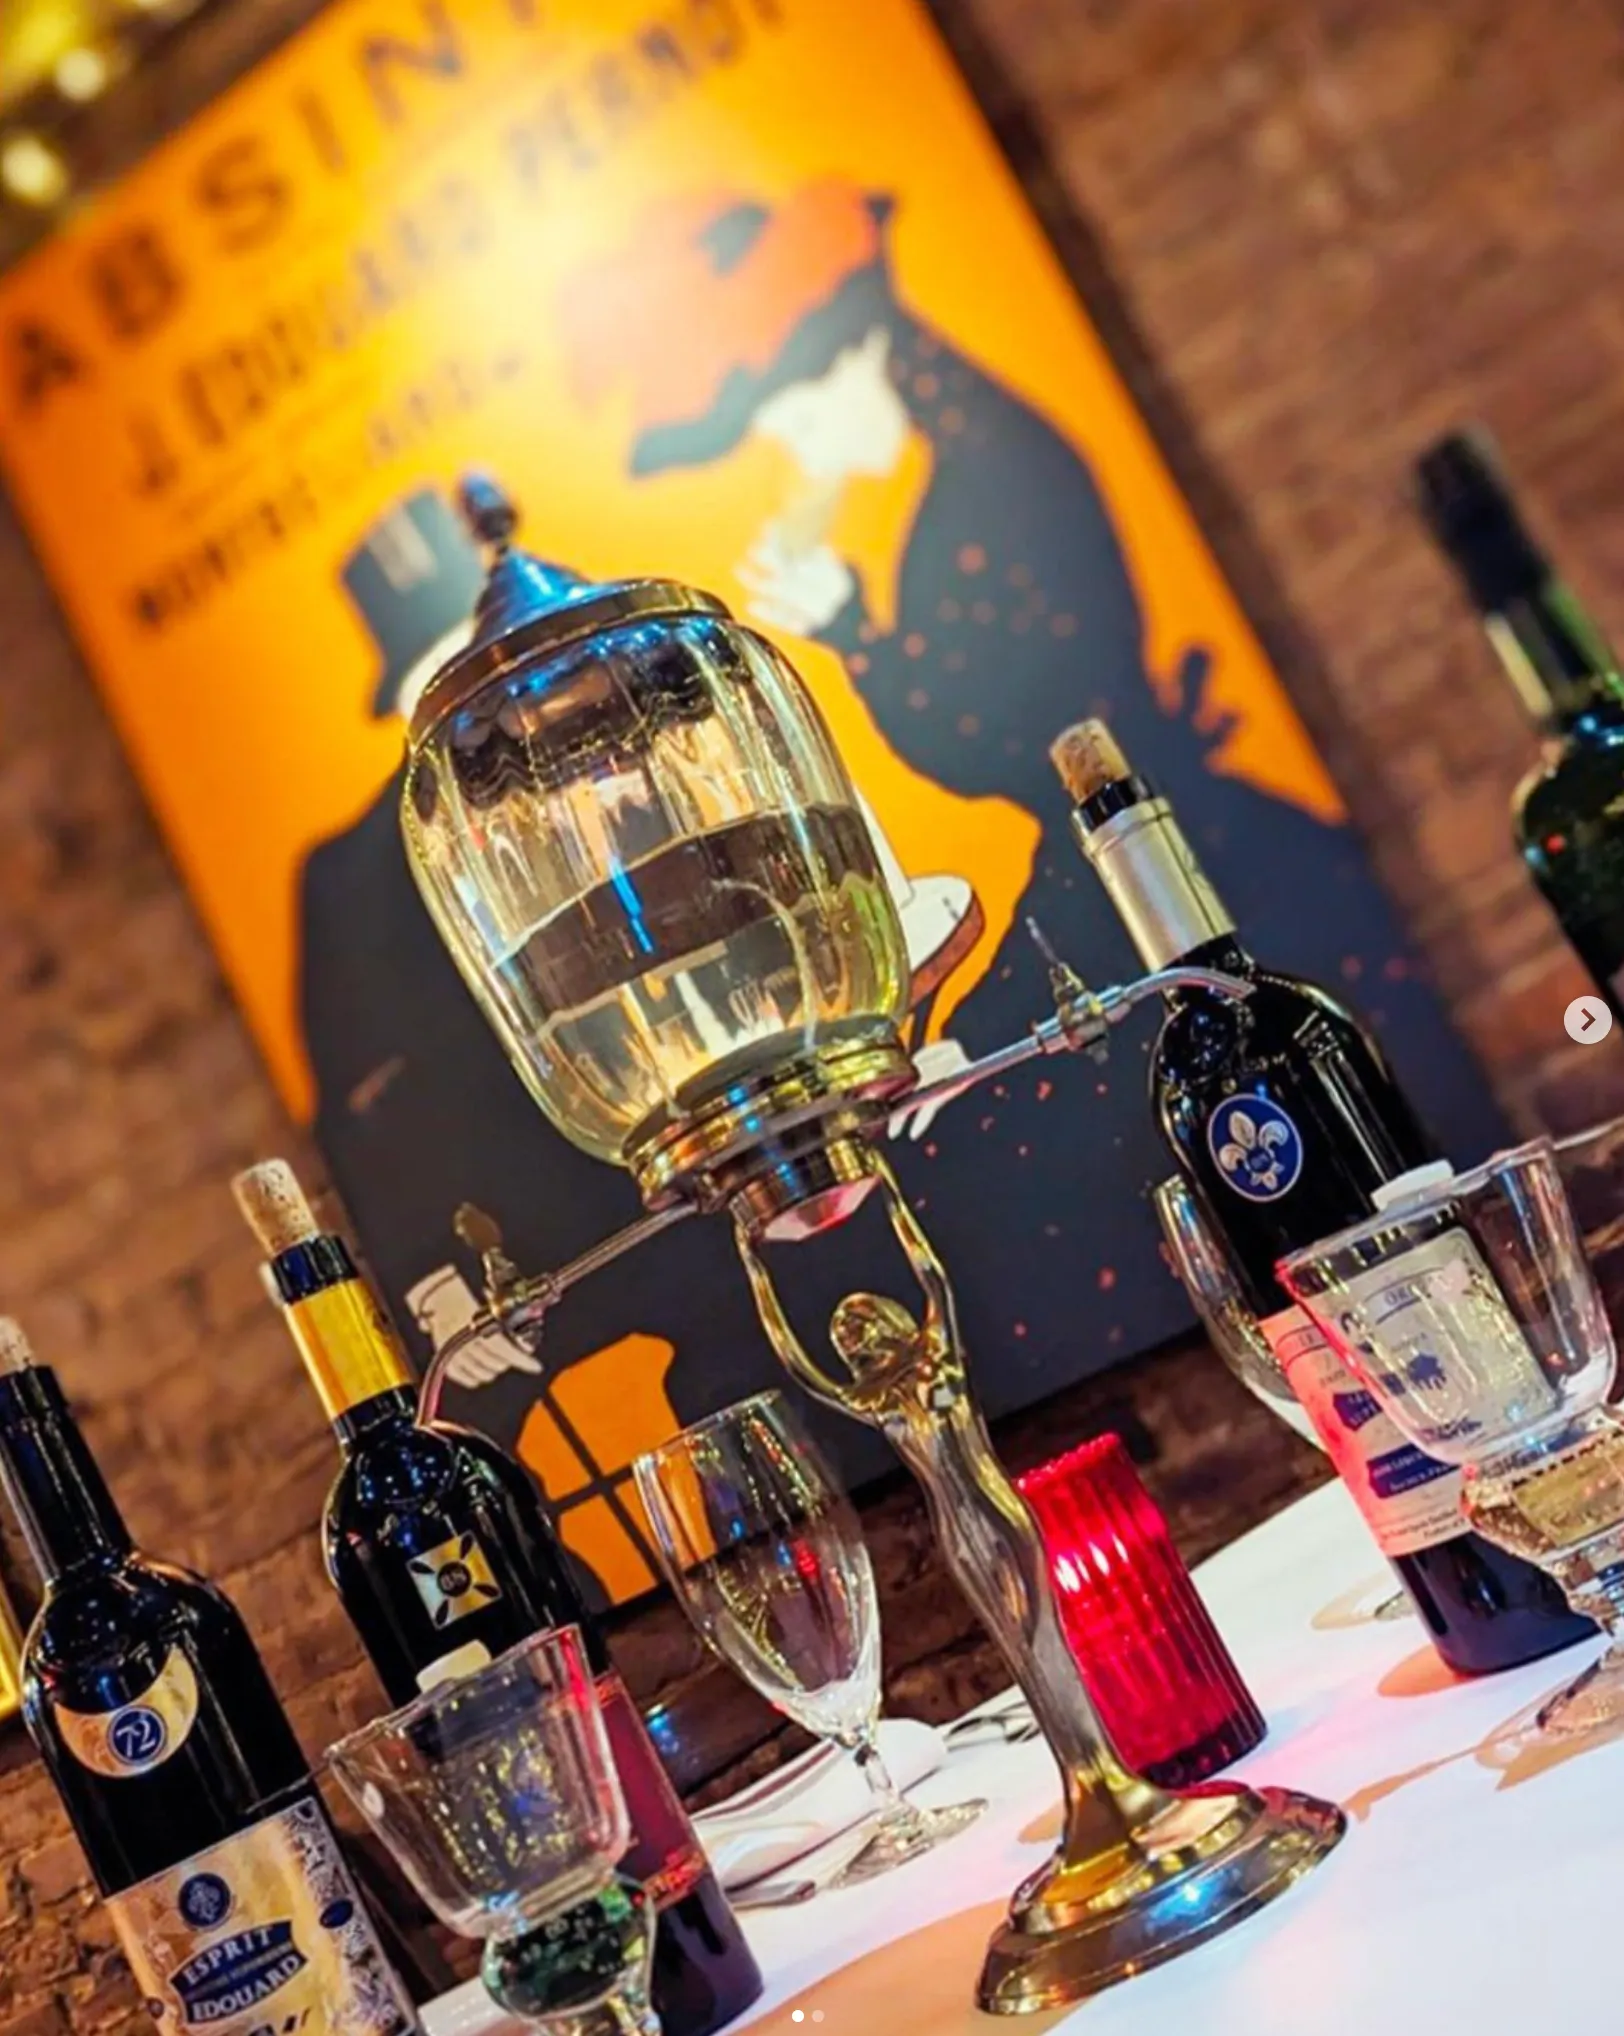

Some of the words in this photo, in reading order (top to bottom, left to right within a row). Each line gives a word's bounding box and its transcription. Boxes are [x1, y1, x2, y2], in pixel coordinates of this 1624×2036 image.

[115, 1718, 158, 1758] 72
[183, 1926, 272, 1986] ESPRIT
[192, 1955, 300, 2021] EDOUARD
